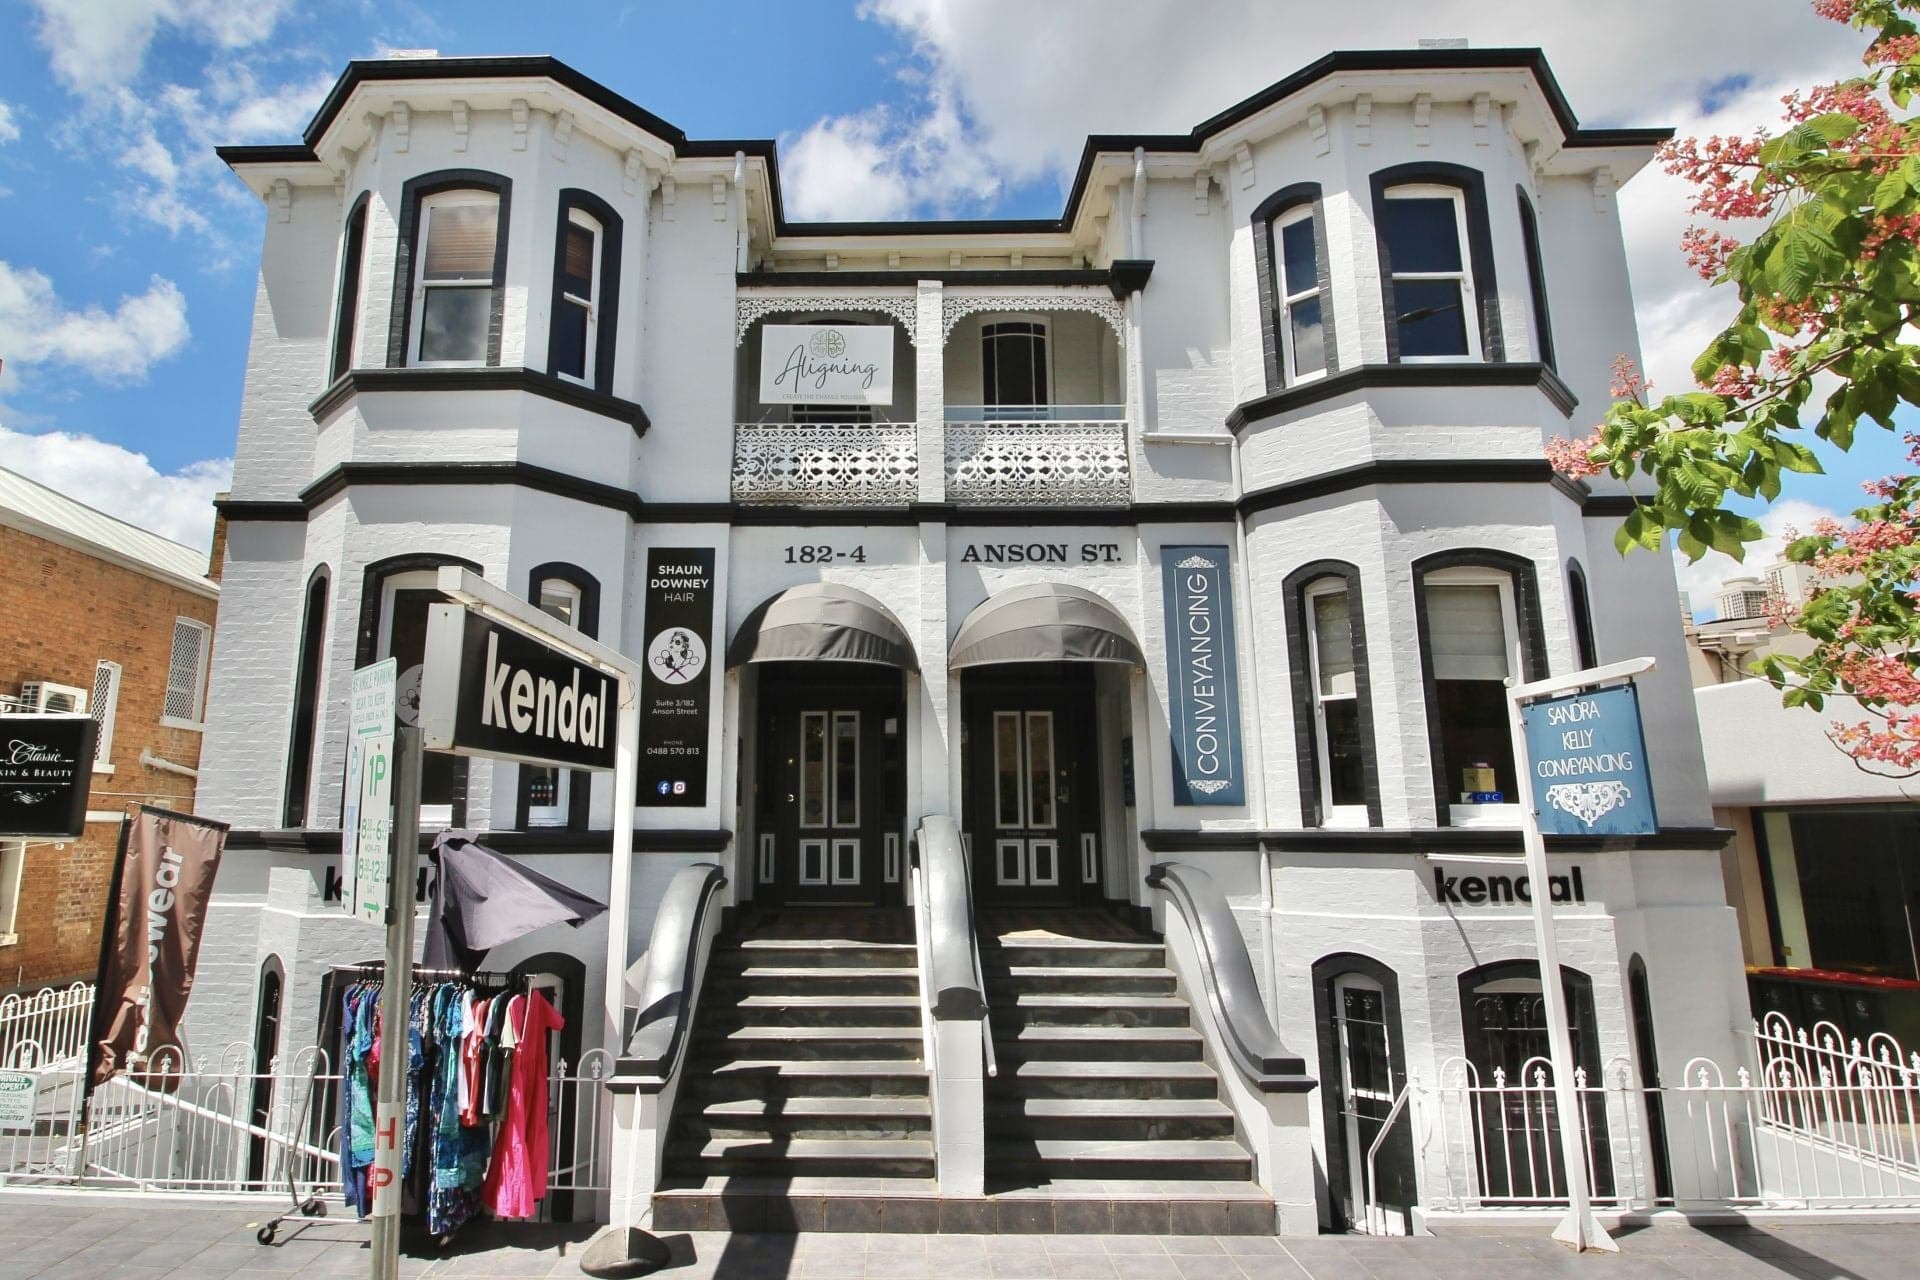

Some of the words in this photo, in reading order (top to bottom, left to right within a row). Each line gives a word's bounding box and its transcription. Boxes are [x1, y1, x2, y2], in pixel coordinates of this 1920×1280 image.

[774, 344, 880, 393] Aligning
[784, 545, 866, 564] 182-4
[960, 544, 1068, 563] ANSON
[1081, 544, 1122, 562] ST.
[658, 565, 702, 575] SHAUN
[651, 579, 709, 589] DOWNEY
[664, 592, 694, 602] HAIR
[1186, 573, 1219, 775] CONVEYANCING
[482, 630, 607, 749] kendal
[1548, 700, 1600, 726] SANDRA
[1562, 728, 1593, 750] KELLY
[8, 739, 62, 765] Classic
[647, 747, 668, 755] 0488
[670, 747, 685, 755] 570
[686, 747, 700, 755] 813
[21, 769, 29, 777] &
[34, 769, 73, 777] BEAUTY
[1538, 752, 1633, 778] CONVEYANCING
[369, 754, 386, 797] 1P
[0, 1082, 29, 1091] OPERTY
